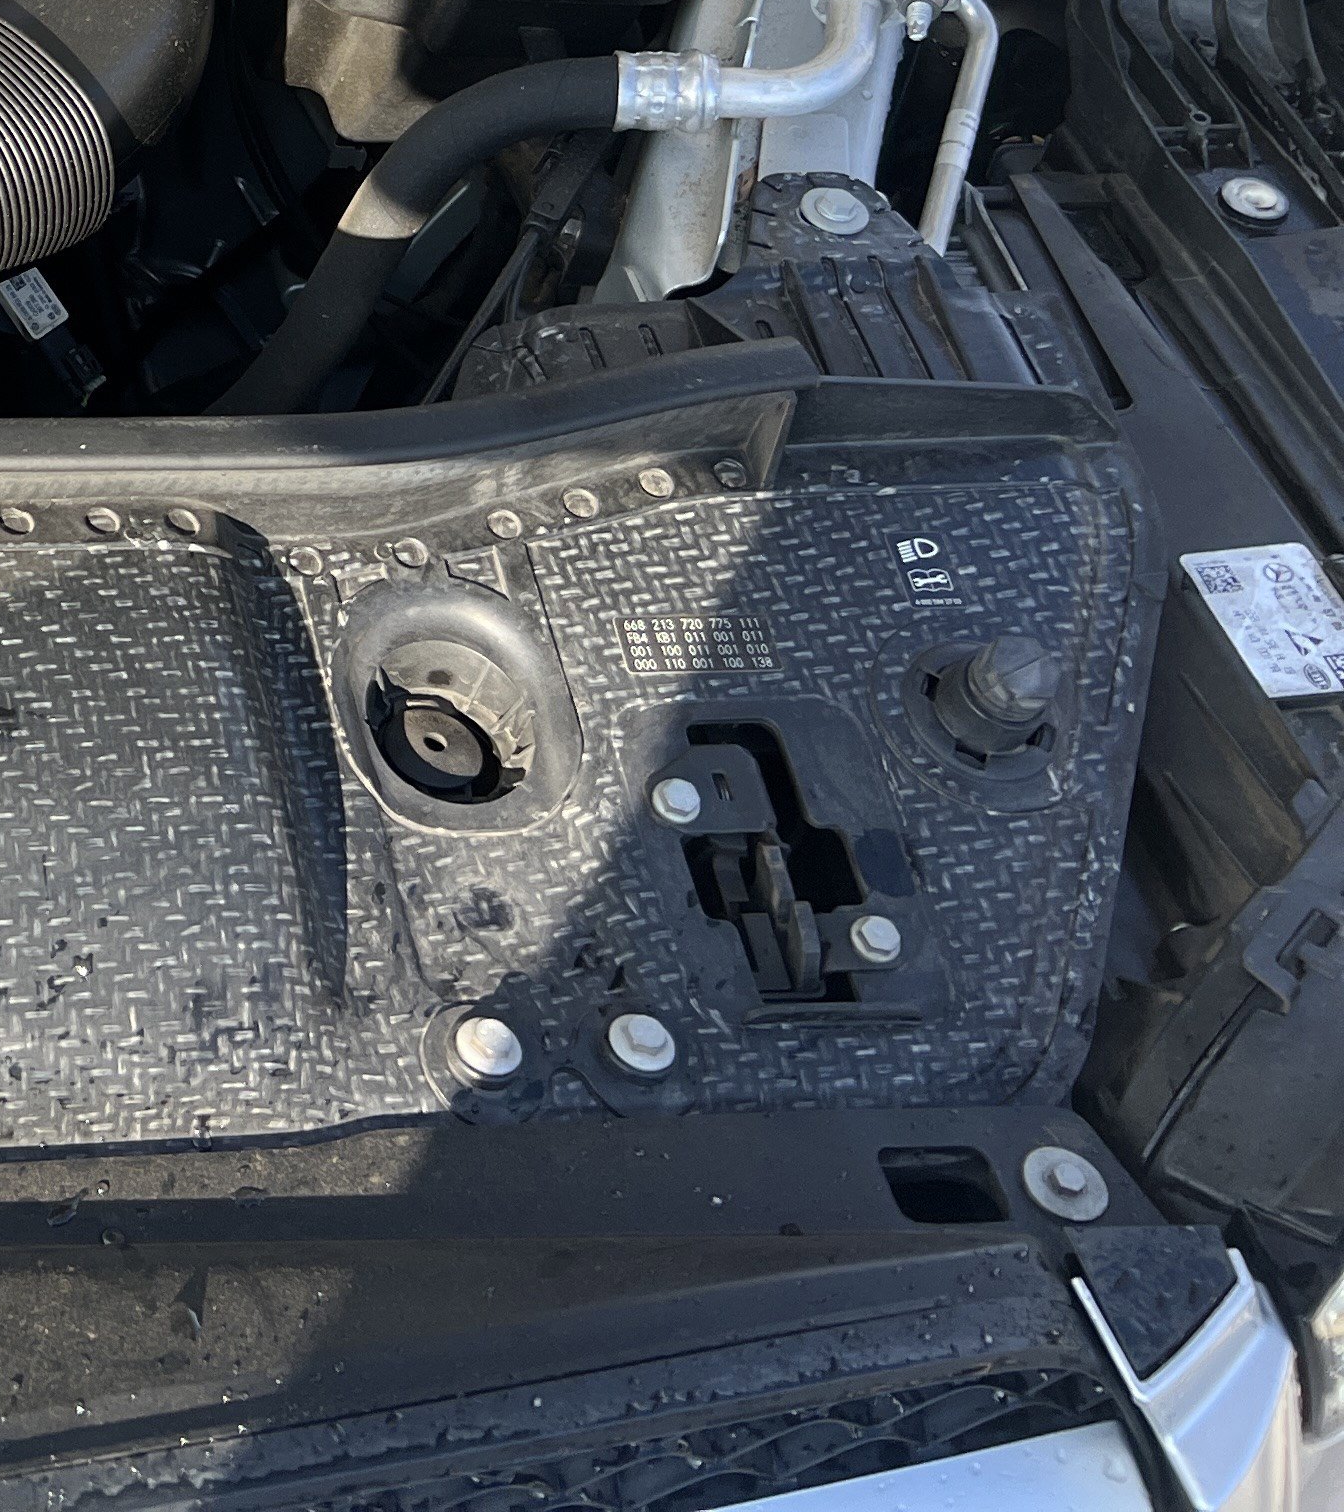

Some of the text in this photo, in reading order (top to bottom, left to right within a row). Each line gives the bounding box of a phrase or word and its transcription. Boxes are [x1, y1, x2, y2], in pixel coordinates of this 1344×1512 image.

[623, 618, 760, 631] 668 213 720 775 111
[626, 630, 763, 644] FB4 KB1 011 001 011
[631, 643, 768, 657] 001 100 011 001 010
[634, 657, 773, 671] 000 110 001 100 138
